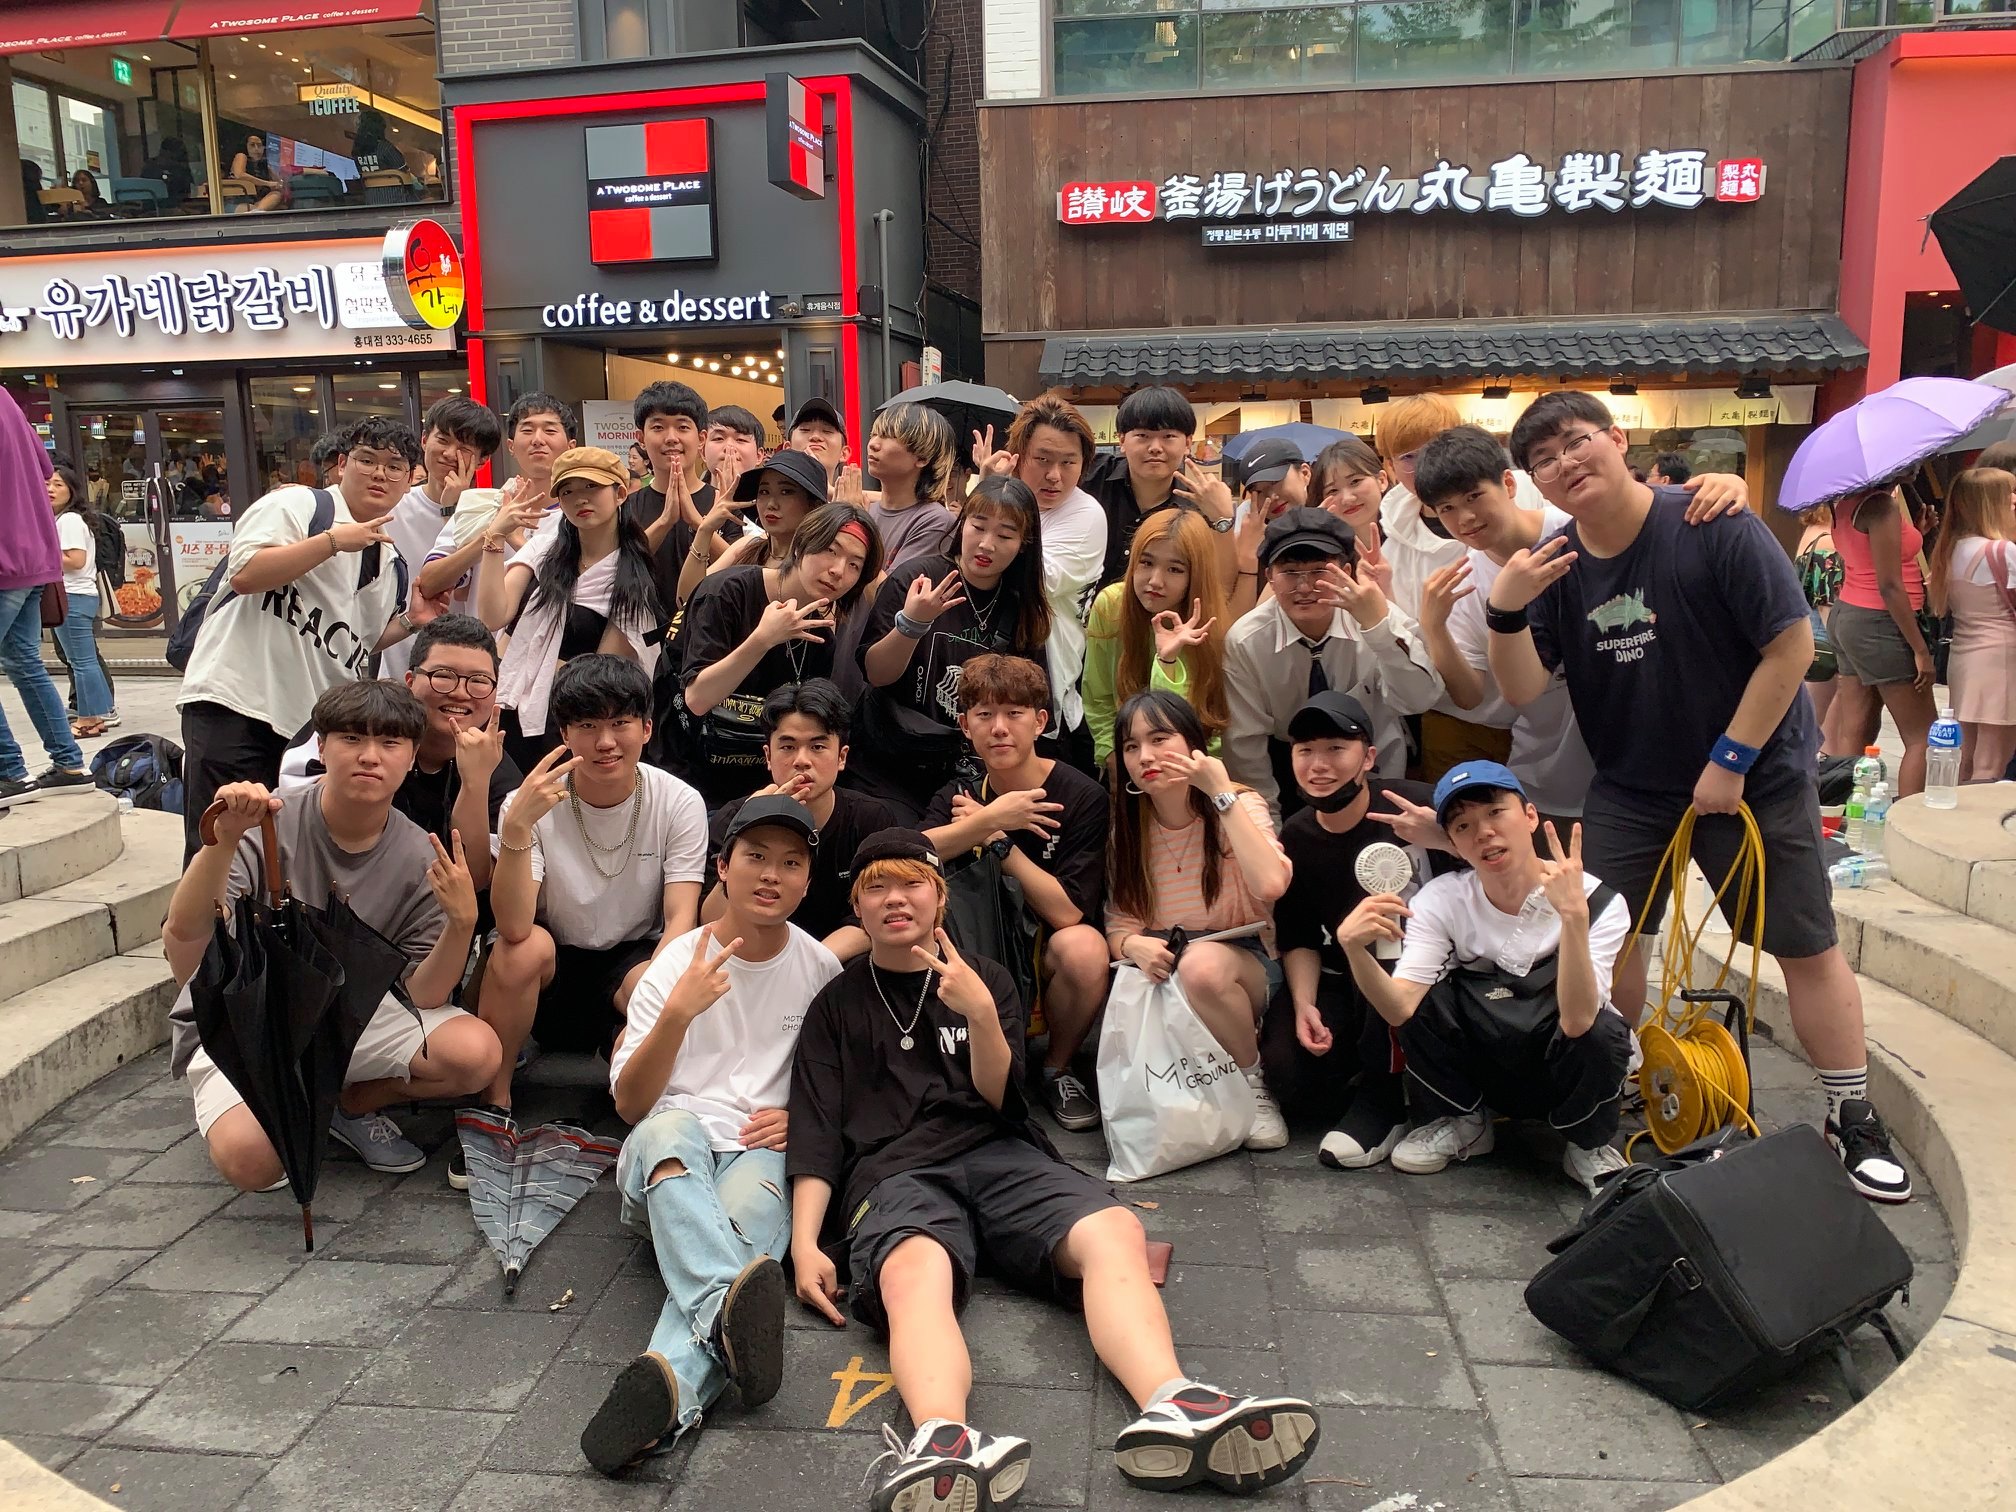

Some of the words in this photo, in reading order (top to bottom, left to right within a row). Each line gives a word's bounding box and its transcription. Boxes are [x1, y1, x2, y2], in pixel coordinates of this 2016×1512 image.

[281, 12, 320, 23] PLACE
[313, 83, 352, 97] Quality
[597, 187, 605, 195] A
[605, 183, 661, 194] TWOSOME
[663, 181, 701, 191] PLACE
[1160, 166, 1405, 221] 釜揚げうどん
[625, 195, 645, 203] coffee
[1265, 223, 1319, 241] 마루가메
[1322, 222, 1349, 239] 제면
[37, 264, 338, 340] 유가네닭갈비
[542, 292, 631, 328] coffee
[639, 297, 657, 323] &
[662, 289, 771, 323] dessert
[806, 301, 841, 311] 휴게음식점
[354, 334, 384, 348] 홍대점
[385, 333, 433, 345] 333-4655
[594, 422, 638, 431] TWOSO
[1596, 629, 1657, 651] SUPERFIRE
[1615, 647, 1645, 663] DINO
[915, 665, 924, 704] TOKYO
[1186, 1060, 1238, 1089] GROUND
